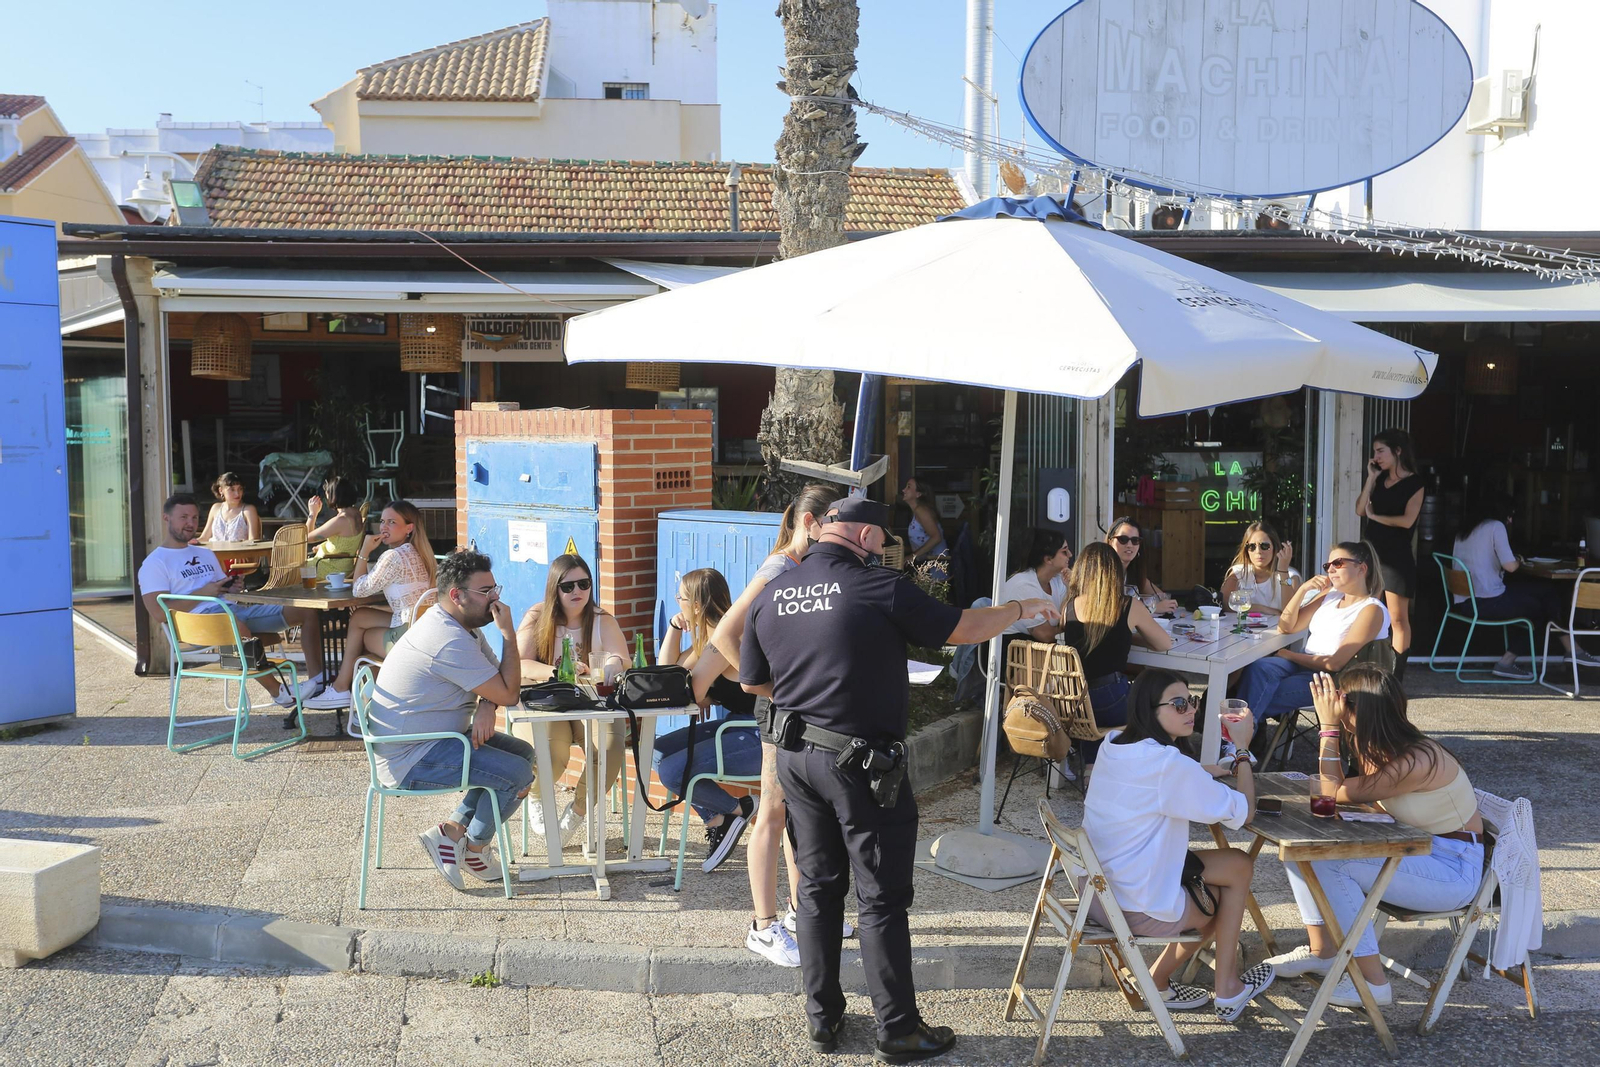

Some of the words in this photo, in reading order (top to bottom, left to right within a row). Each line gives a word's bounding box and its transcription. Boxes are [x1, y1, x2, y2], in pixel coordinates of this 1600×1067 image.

[1229, 0, 1277, 26] LA
[1104, 19, 1396, 99] MACHINA
[1100, 112, 1198, 140] FOOD
[1217, 115, 1243, 143] &
[1257, 115, 1393, 145] DRINKS
[529, 342, 552, 350] CENTER
[1059, 365, 1100, 373] CERVECISTAS
[1214, 461, 1243, 476] LA
[773, 582, 842, 601] POLICIA
[777, 597, 833, 616] LOCAL
